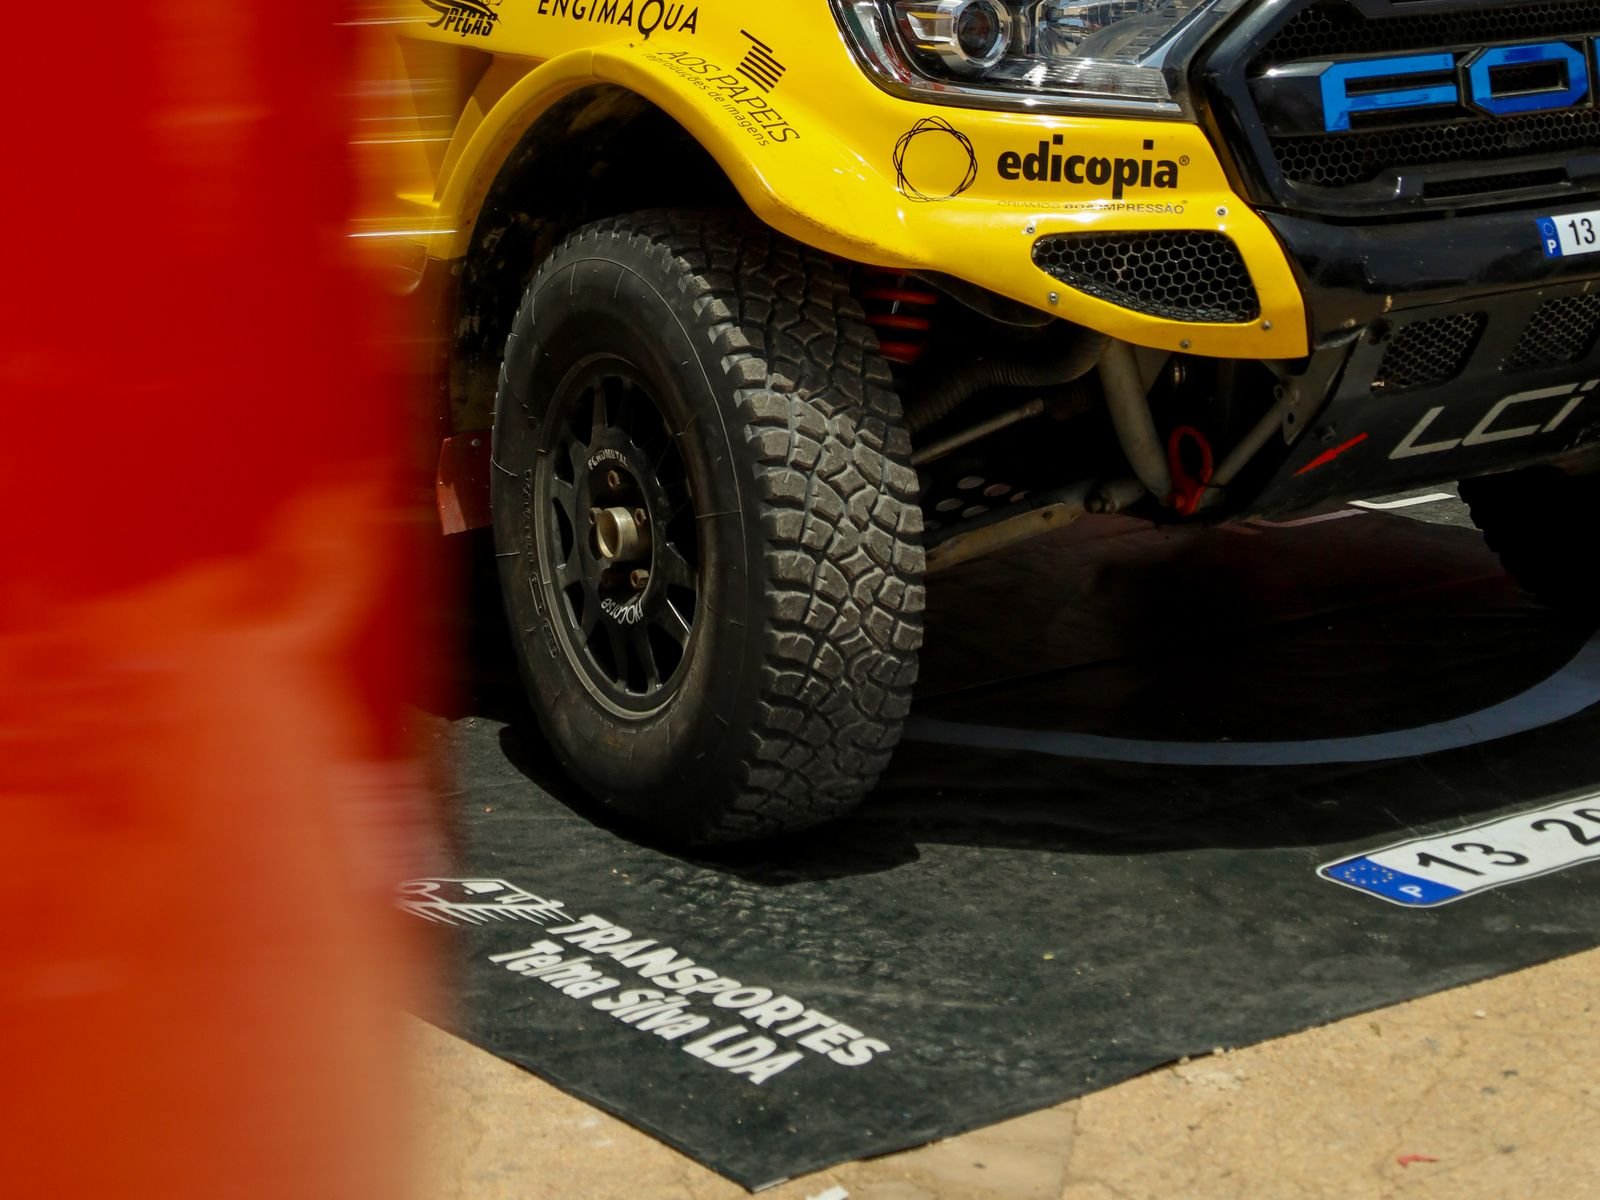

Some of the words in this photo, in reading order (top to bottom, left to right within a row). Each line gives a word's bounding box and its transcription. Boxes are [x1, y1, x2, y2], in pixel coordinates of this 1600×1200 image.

[443, 7, 494, 37] PEÇAS
[656, 51, 721, 74] AOS
[707, 74, 801, 143] PAPEIS
[707, 90, 726, 103] de
[722, 103, 771, 147] imagens
[1319, 37, 1600, 132] FO
[1546, 239, 1557, 254] P
[1568, 218, 1596, 246] 13
[1398, 883, 1424, 898] P
[1416, 842, 1530, 877] 13
[488, 939, 621, 1000] Telma
[591, 988, 711, 1040] Silva
[682, 1025, 805, 1086] LDA
[546, 914, 892, 1067] TRANSPORTES
